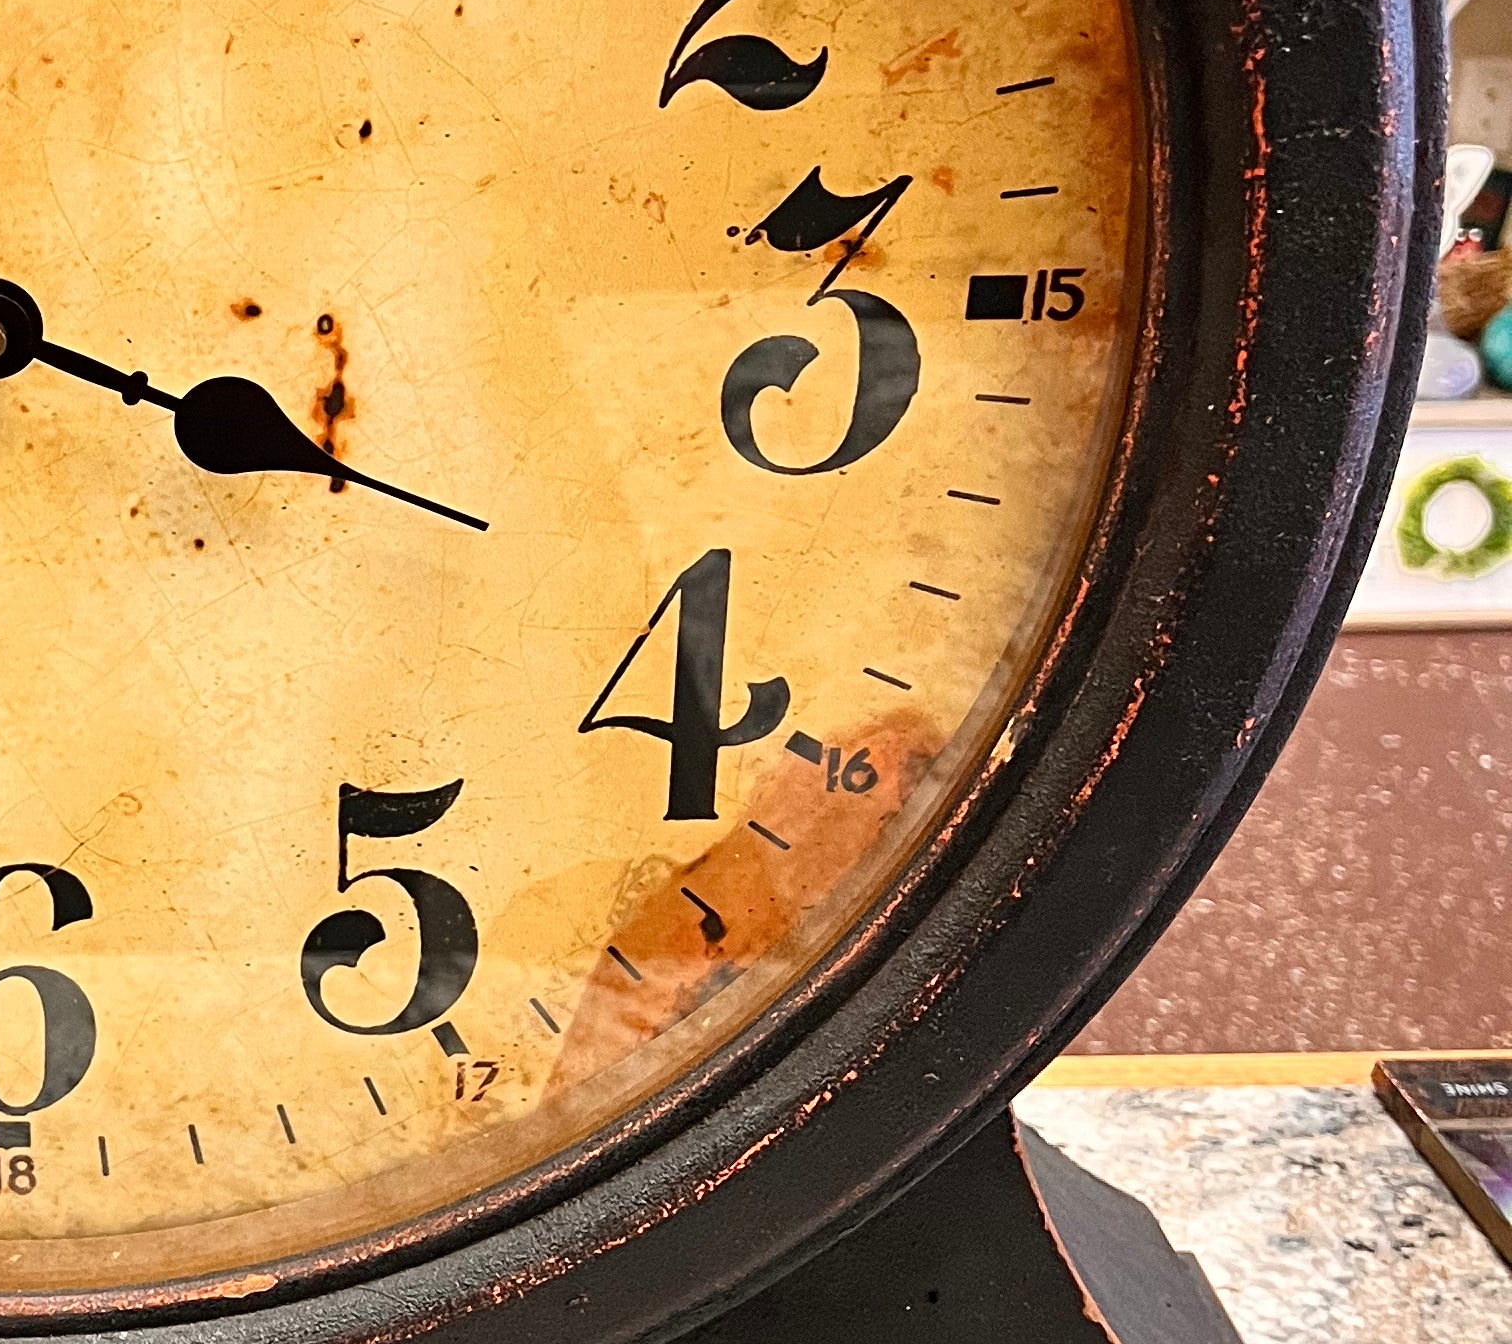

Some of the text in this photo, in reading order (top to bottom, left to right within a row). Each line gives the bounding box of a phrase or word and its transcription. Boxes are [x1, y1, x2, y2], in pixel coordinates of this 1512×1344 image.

[721, 165, 921, 476] 3
[1031, 268, 1087, 322] 15
[578, 548, 790, 820] 4
[826, 746, 879, 794] 16
[301, 778, 478, 1035] 5
[454, 1060, 501, 1102] 17
[1441, 1081, 1509, 1096] SHINE
